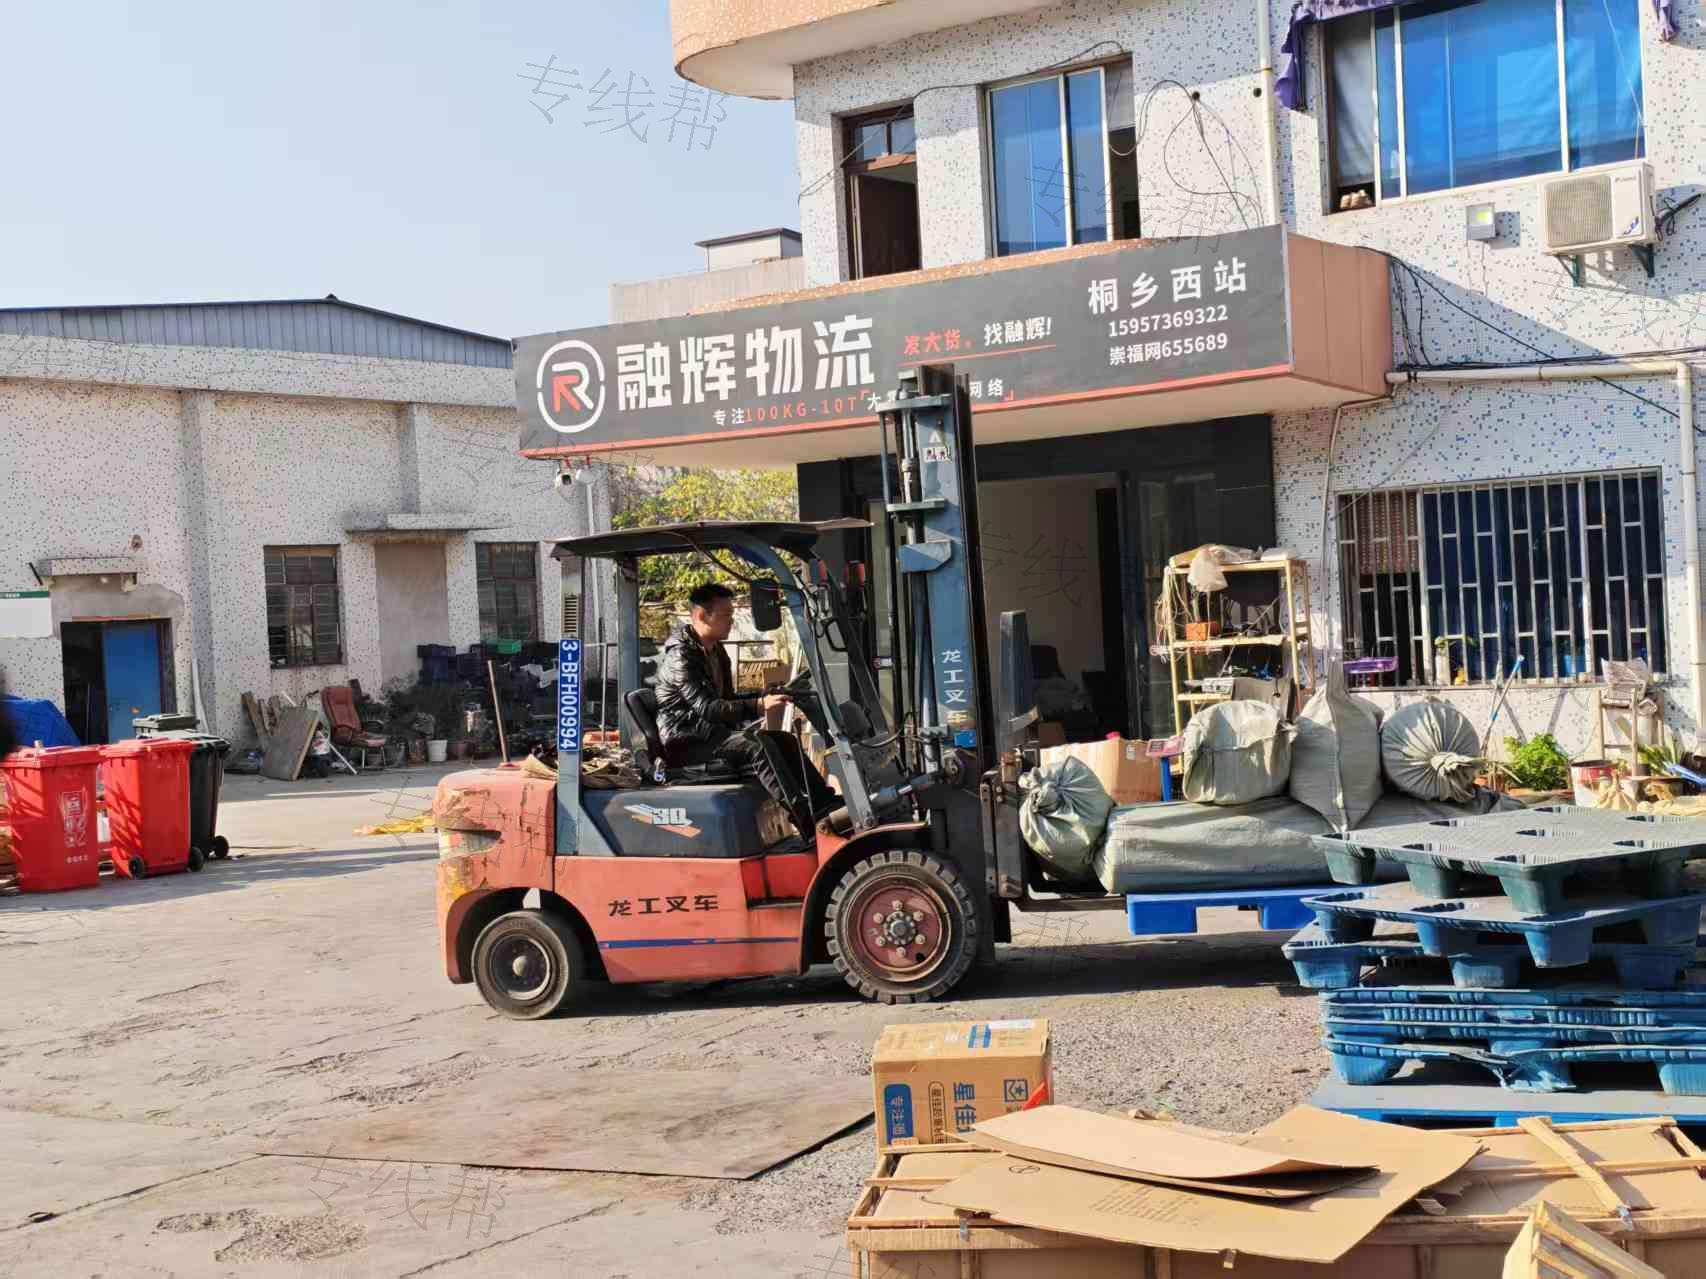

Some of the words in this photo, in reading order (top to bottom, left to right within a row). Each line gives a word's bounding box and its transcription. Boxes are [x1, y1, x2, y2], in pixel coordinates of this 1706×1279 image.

[1088, 256, 1247, 315] 桐乡西站
[1108, 304, 1229, 338] 15957369322
[616, 314, 875, 411] 融辉物流
[1109, 332, 1228, 366] 崇福网655689
[561, 641, 578, 749] 3-BFH00994
[942, 648, 968, 724] 龙工叉车
[608, 895, 719, 916] 龙工叉车
[953, 1082, 977, 1134] 星佳
